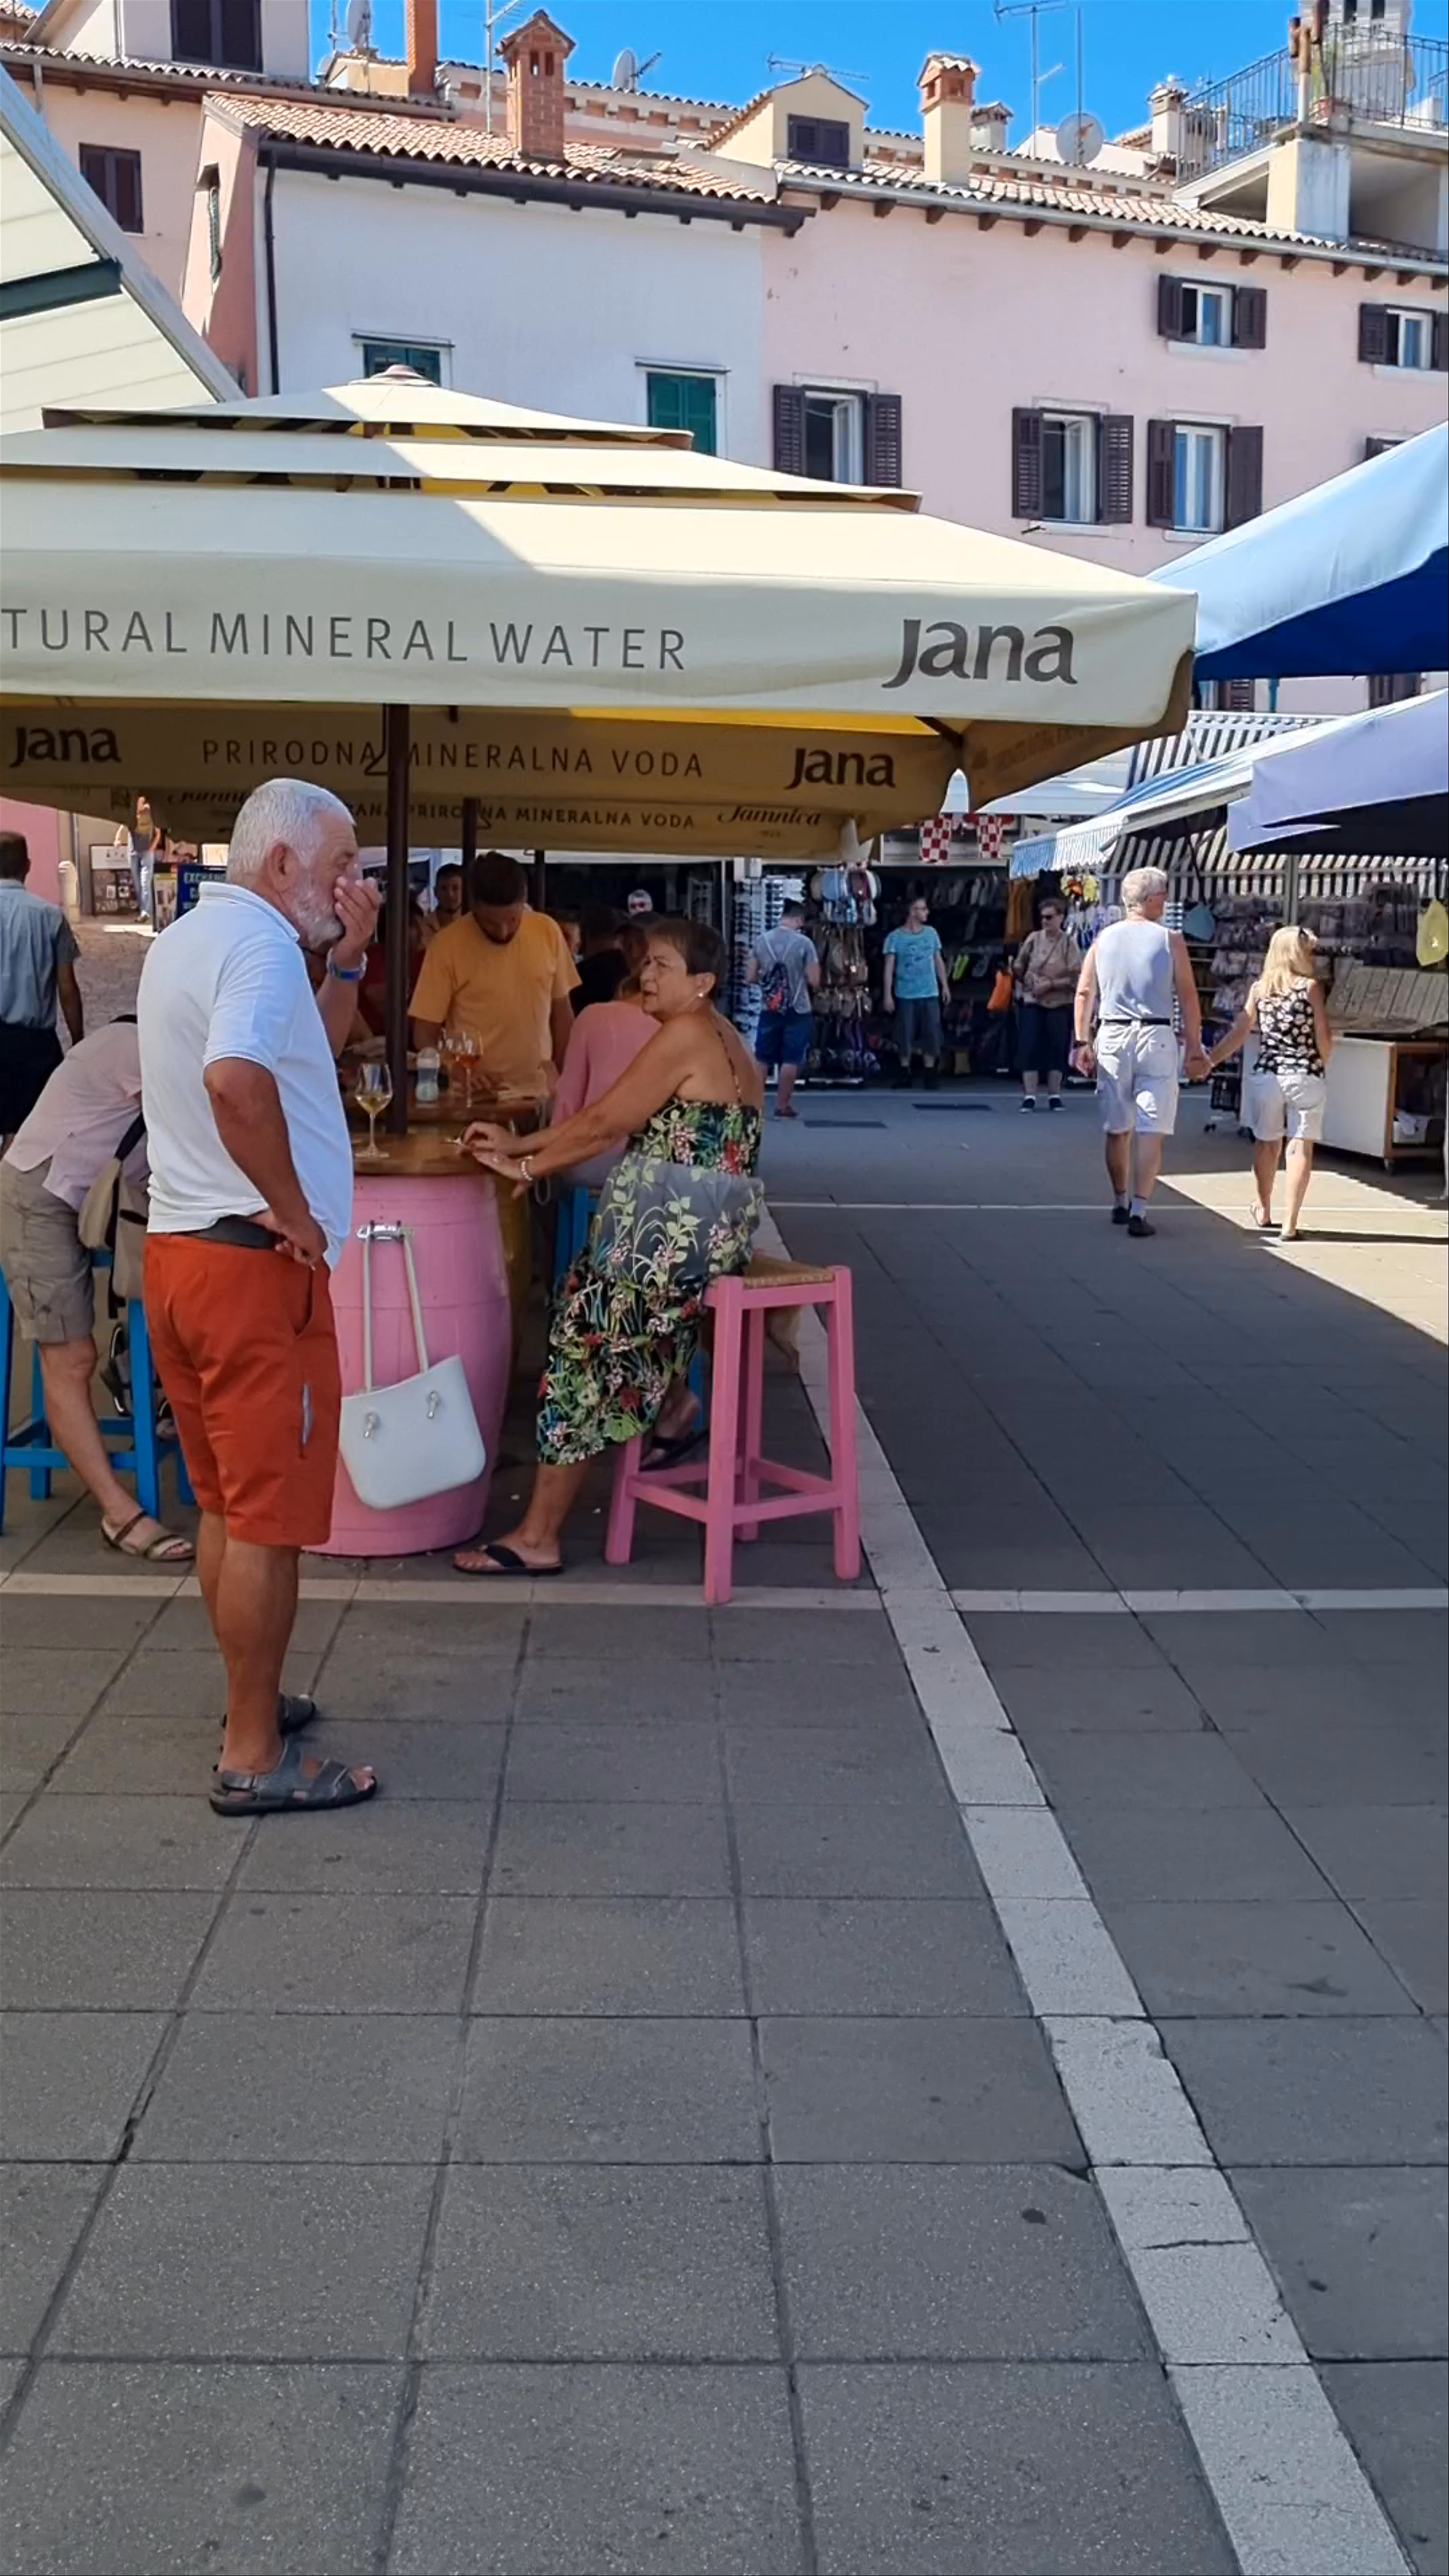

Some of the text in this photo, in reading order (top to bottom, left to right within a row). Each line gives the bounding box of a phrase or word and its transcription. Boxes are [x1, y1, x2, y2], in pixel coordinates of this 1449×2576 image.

[1, 608, 684, 670] TURAL MINERAL WATER
[881, 619, 1078, 688] Jana
[10, 727, 122, 768] Jana
[203, 740, 378, 765] PRIRODNA
[612, 750, 702, 778] VODA
[784, 748, 896, 790] Jana
[516, 808, 631, 825] MINERALNA
[641, 812, 694, 828] VODA
